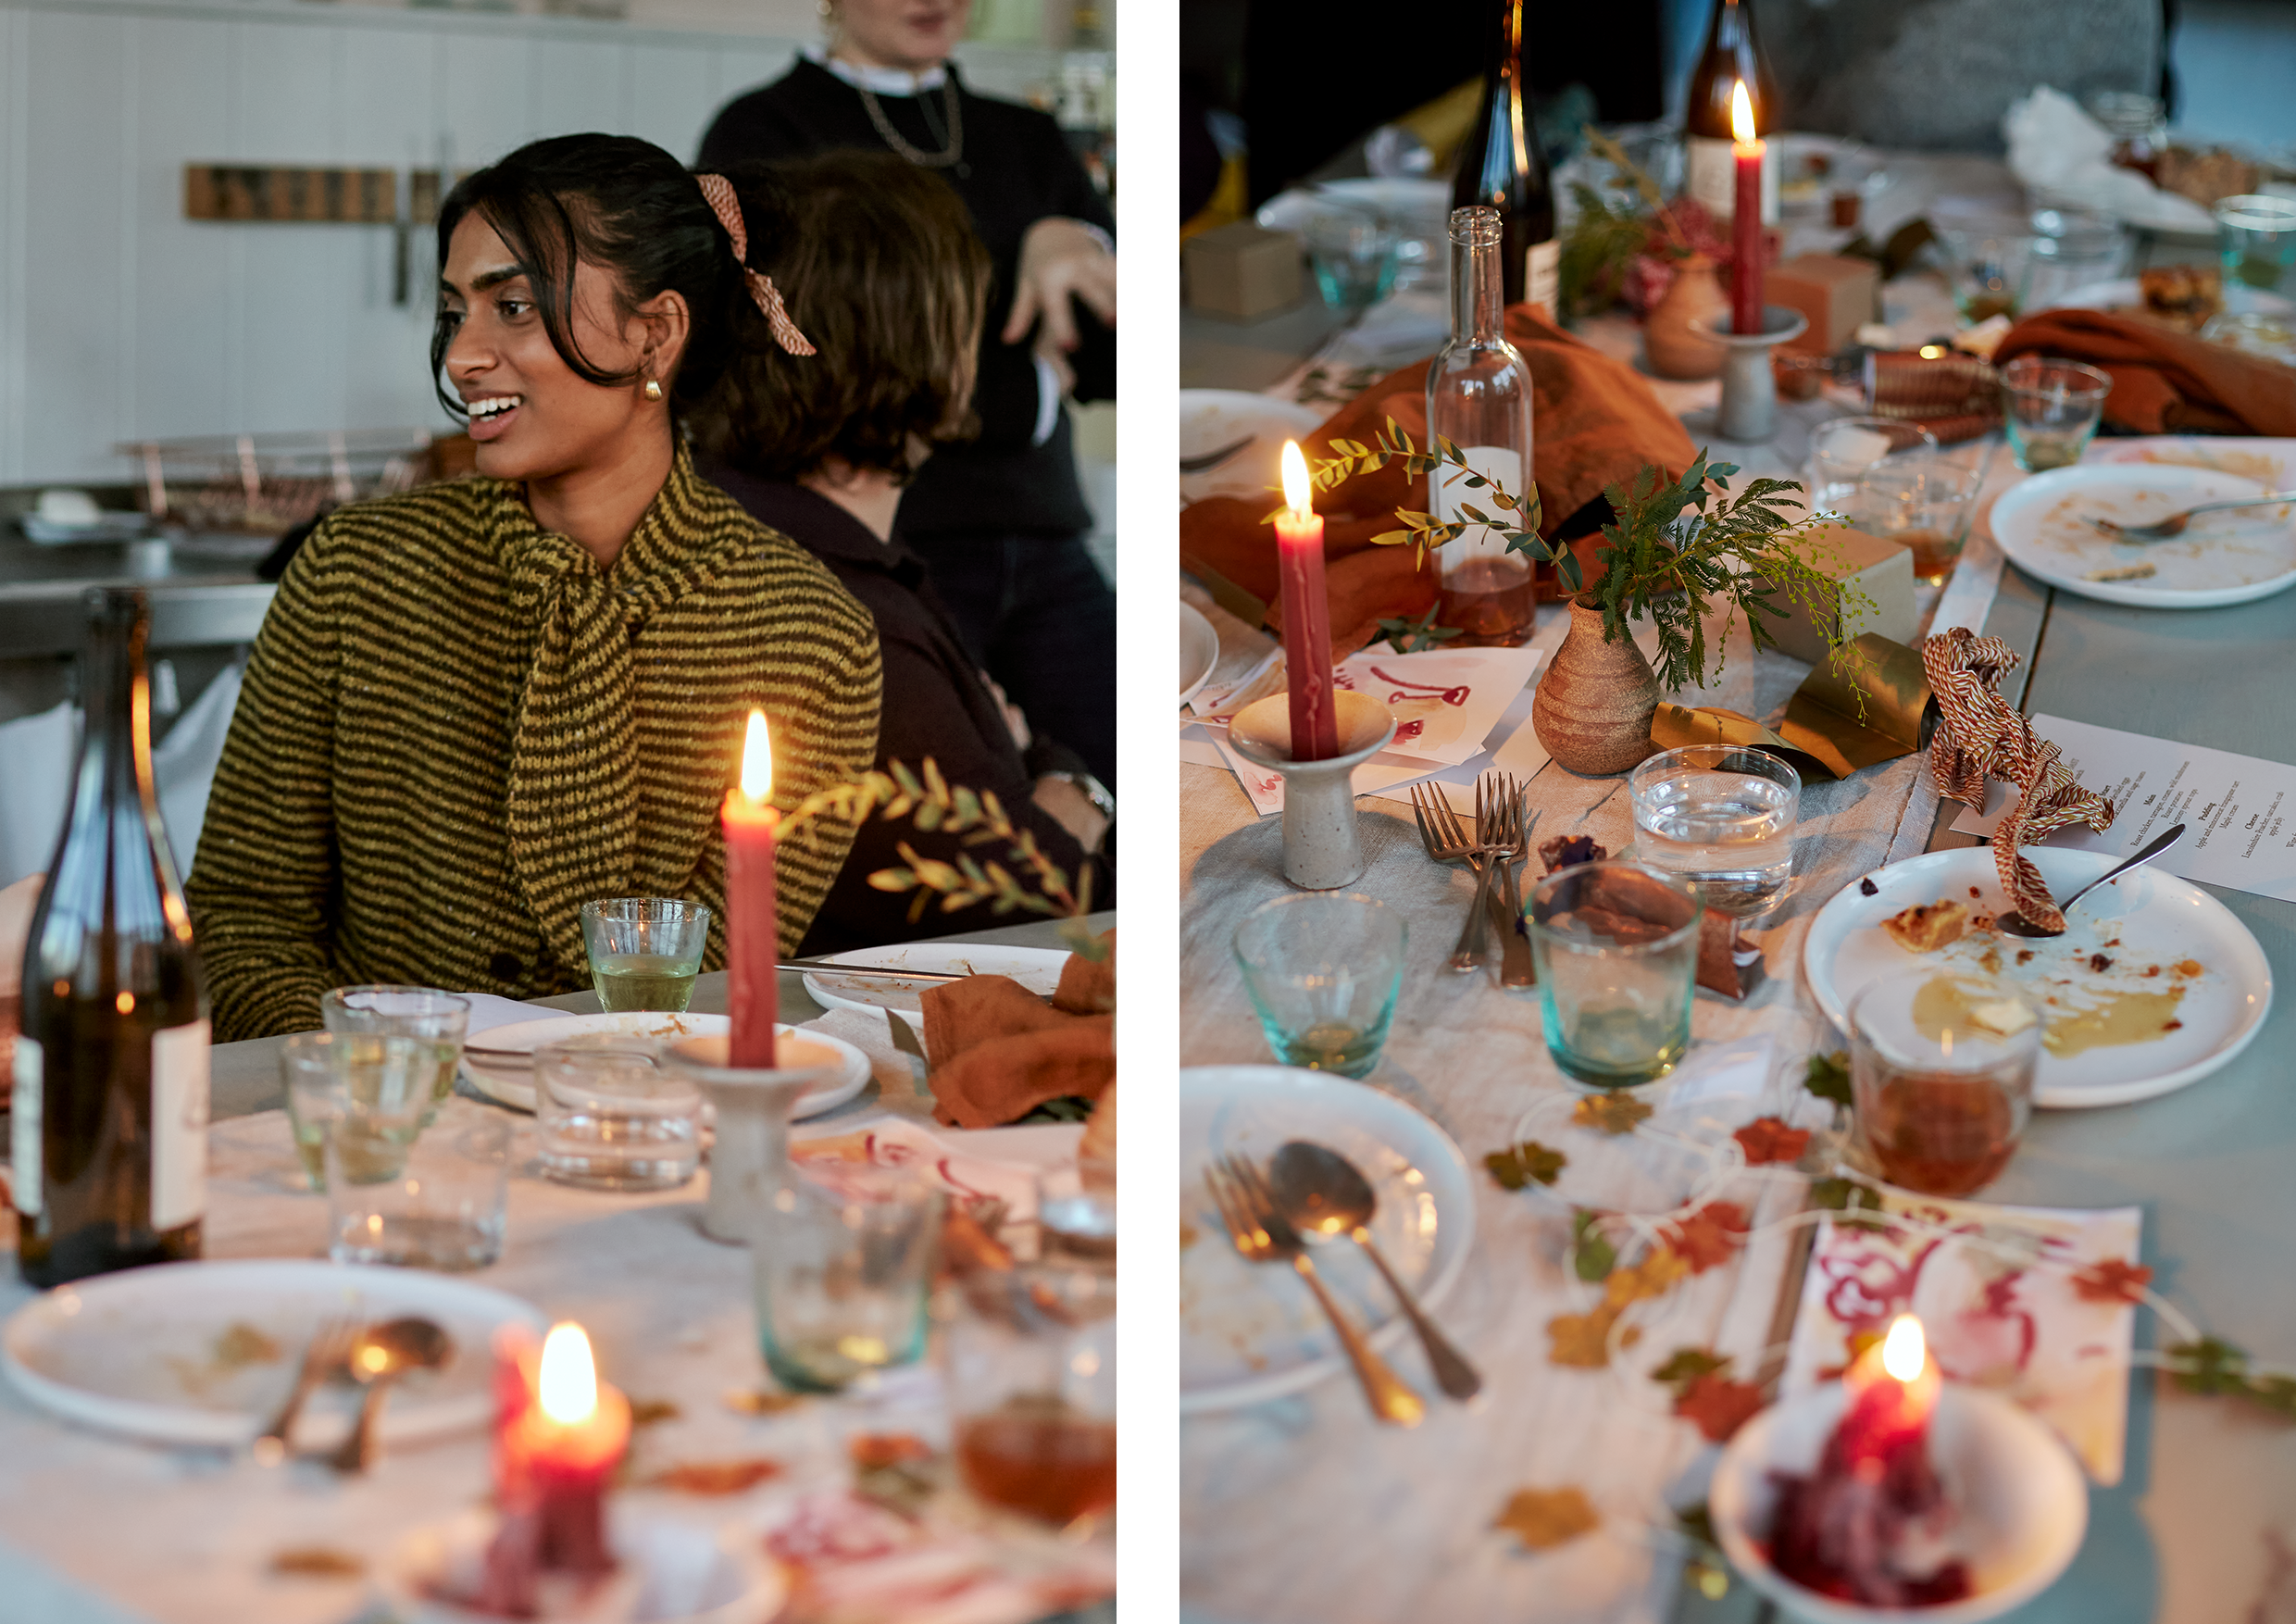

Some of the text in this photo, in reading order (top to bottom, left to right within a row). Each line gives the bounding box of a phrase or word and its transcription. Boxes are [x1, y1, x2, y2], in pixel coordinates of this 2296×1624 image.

[2143, 794, 2157, 806] Main
[2160, 791, 2184, 818] Roast potatoes
[2169, 810, 2188, 825] Lemony
[2198, 802, 2217, 821] Pudding
[2219, 805, 2240, 829] Maple cream
[2244, 813, 2259, 830] Cheese
[2129, 834, 2144, 846] Roast
[2139, 818, 2155, 835] chicken,
[2240, 833, 2262, 859] Lincolnshire
[2254, 818, 2272, 834] Poacher,
[2269, 825, 2279, 837] apple
[2195, 837, 2208, 849] Apple
